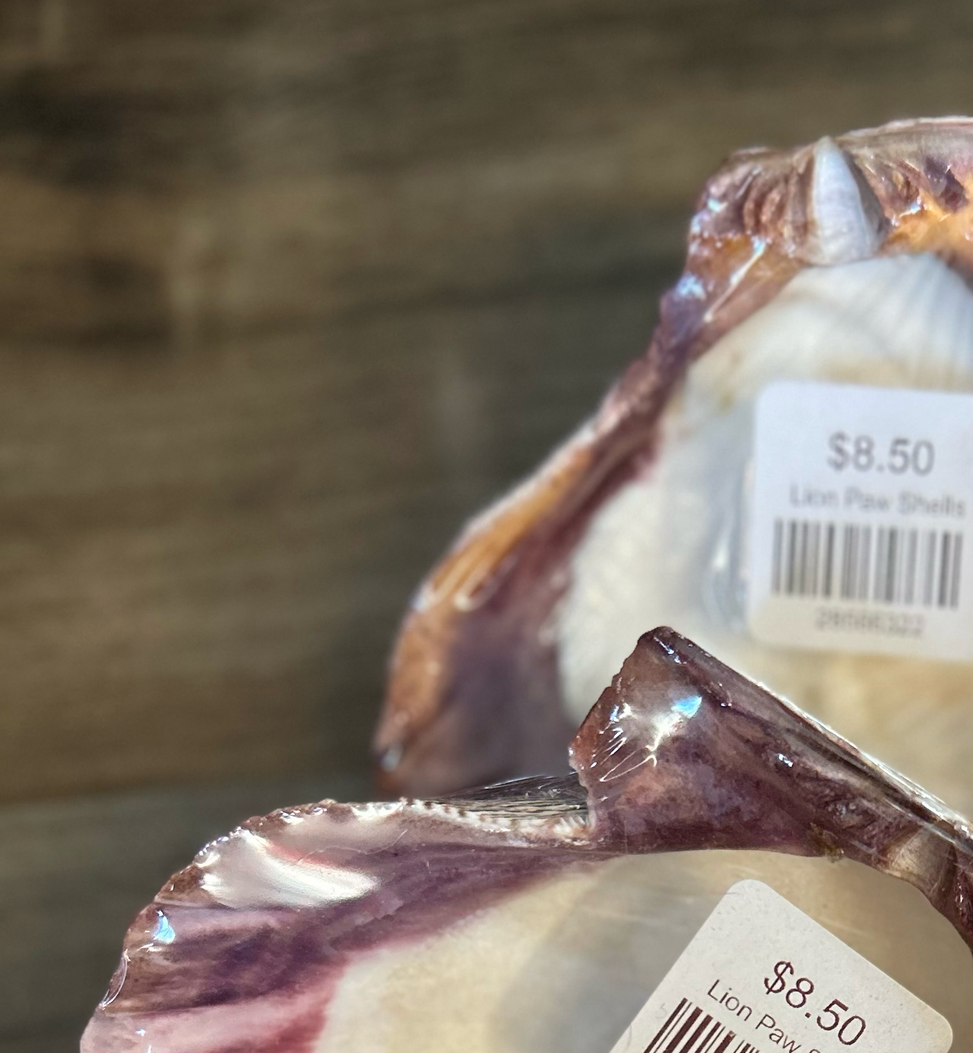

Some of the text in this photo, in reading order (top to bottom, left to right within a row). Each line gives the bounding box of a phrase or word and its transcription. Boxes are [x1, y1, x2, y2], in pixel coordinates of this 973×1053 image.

[827, 431, 935, 476] $8.50
[789, 483, 966, 517] Lion Paw Shells
[706, 979, 753, 1022] Lion
[763, 960, 867, 1046] $8.50
